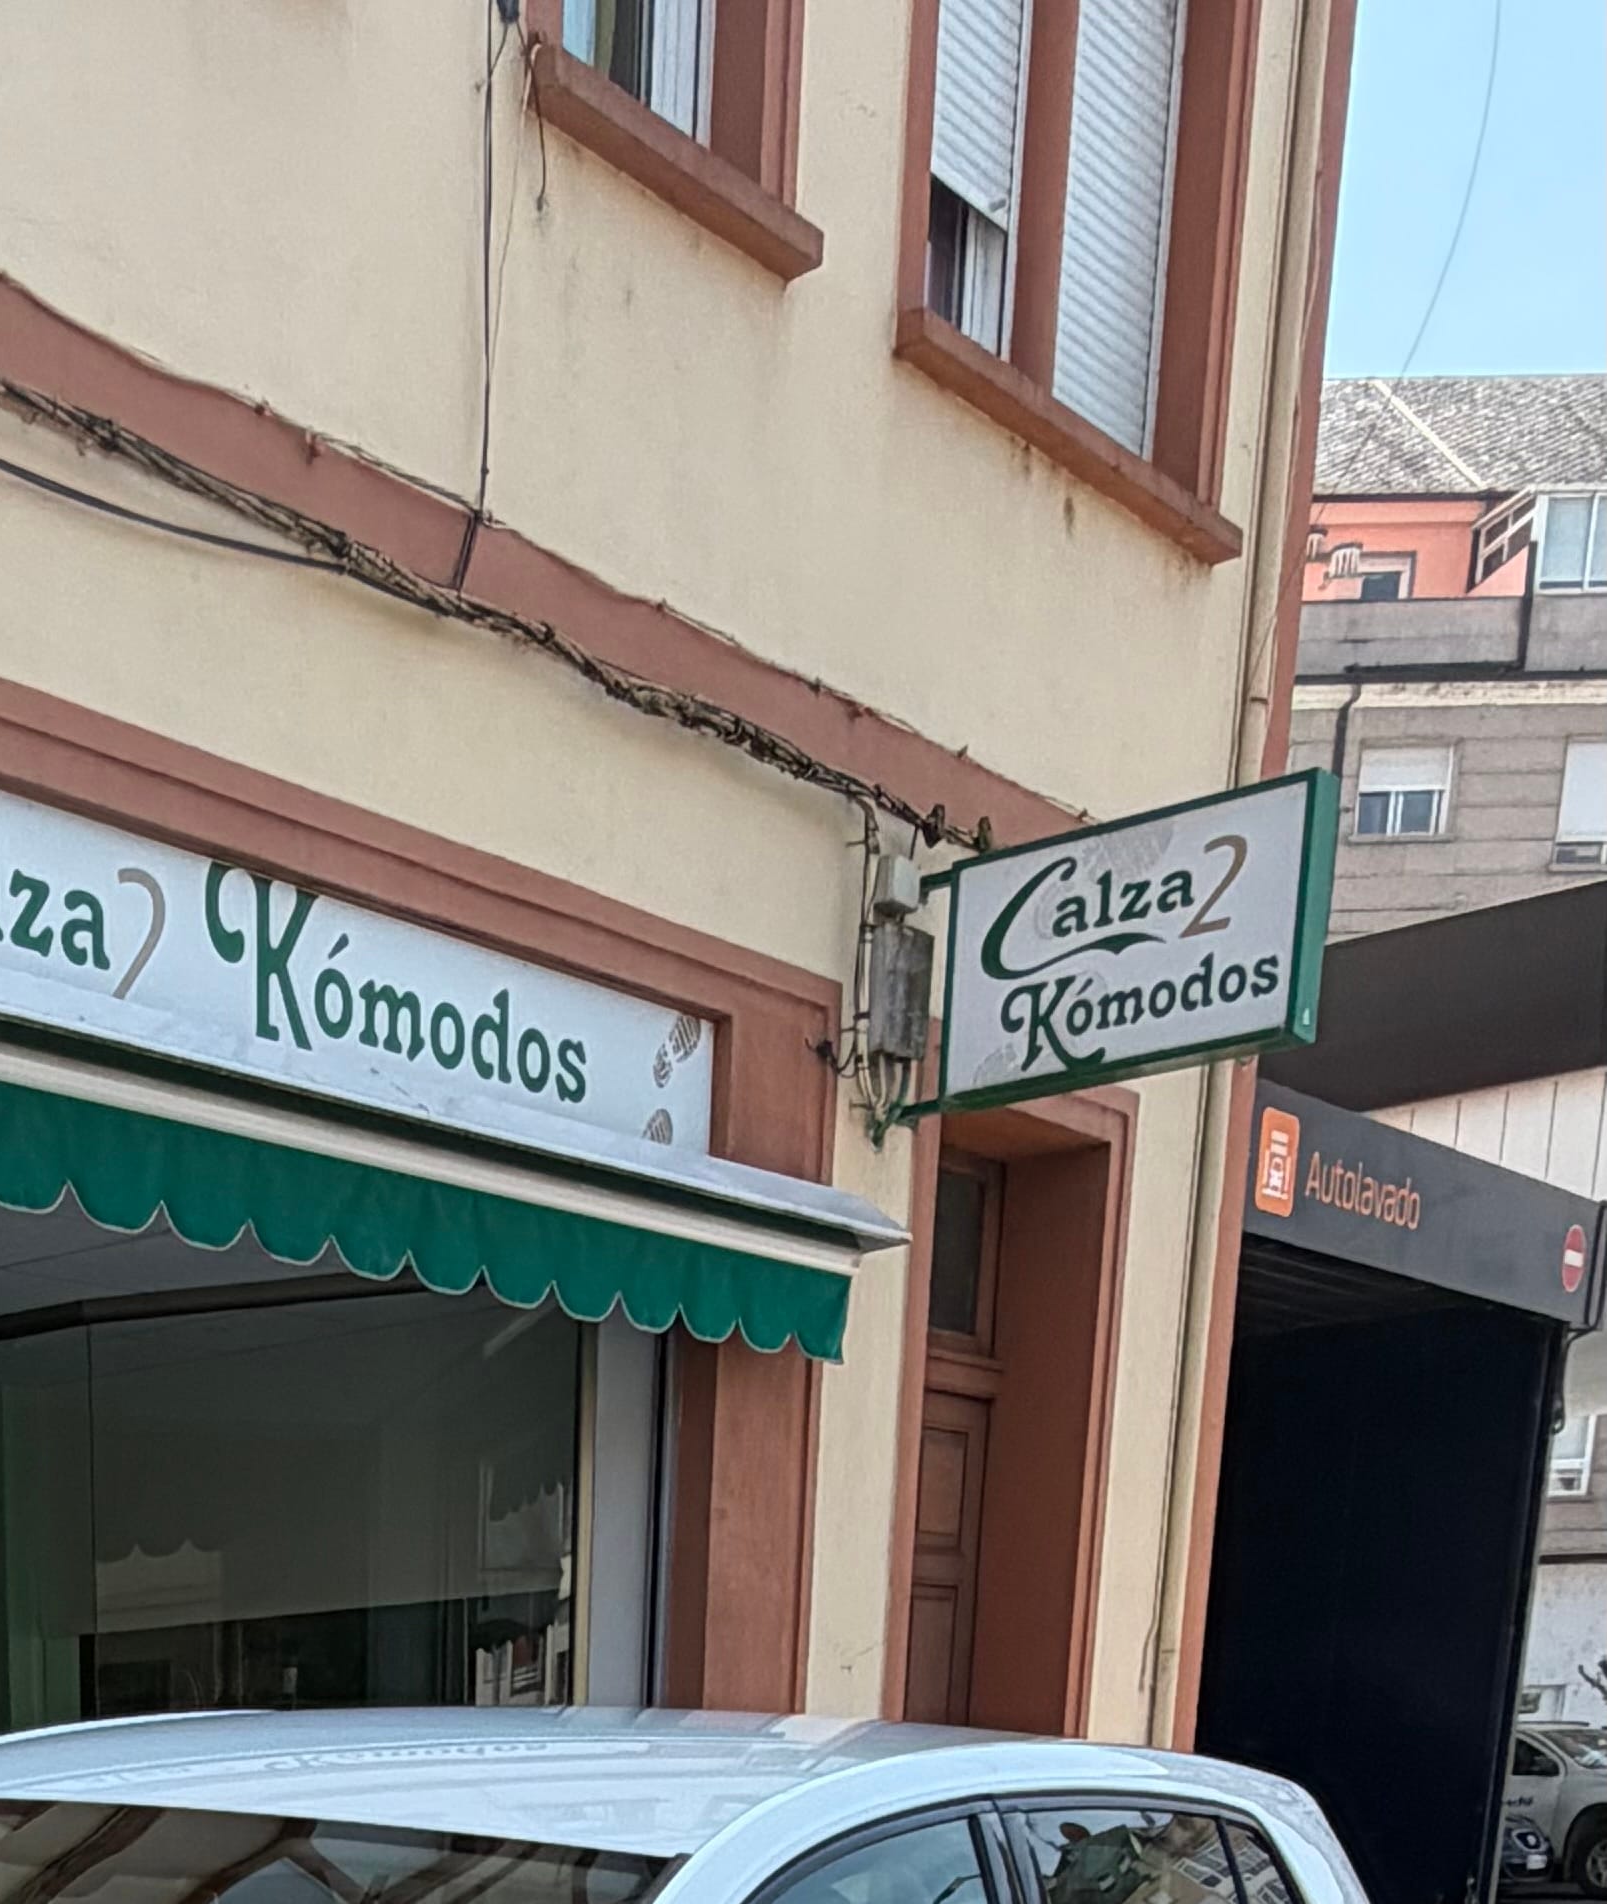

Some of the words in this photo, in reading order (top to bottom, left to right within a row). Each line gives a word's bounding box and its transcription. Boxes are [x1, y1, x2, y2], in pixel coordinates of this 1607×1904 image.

[980, 834, 1248, 980] Calza2
[205, 860, 587, 1103] Kómodos
[1000, 952, 1280, 1071] Kómodos
[1305, 1151, 1421, 1231] Autolavado
